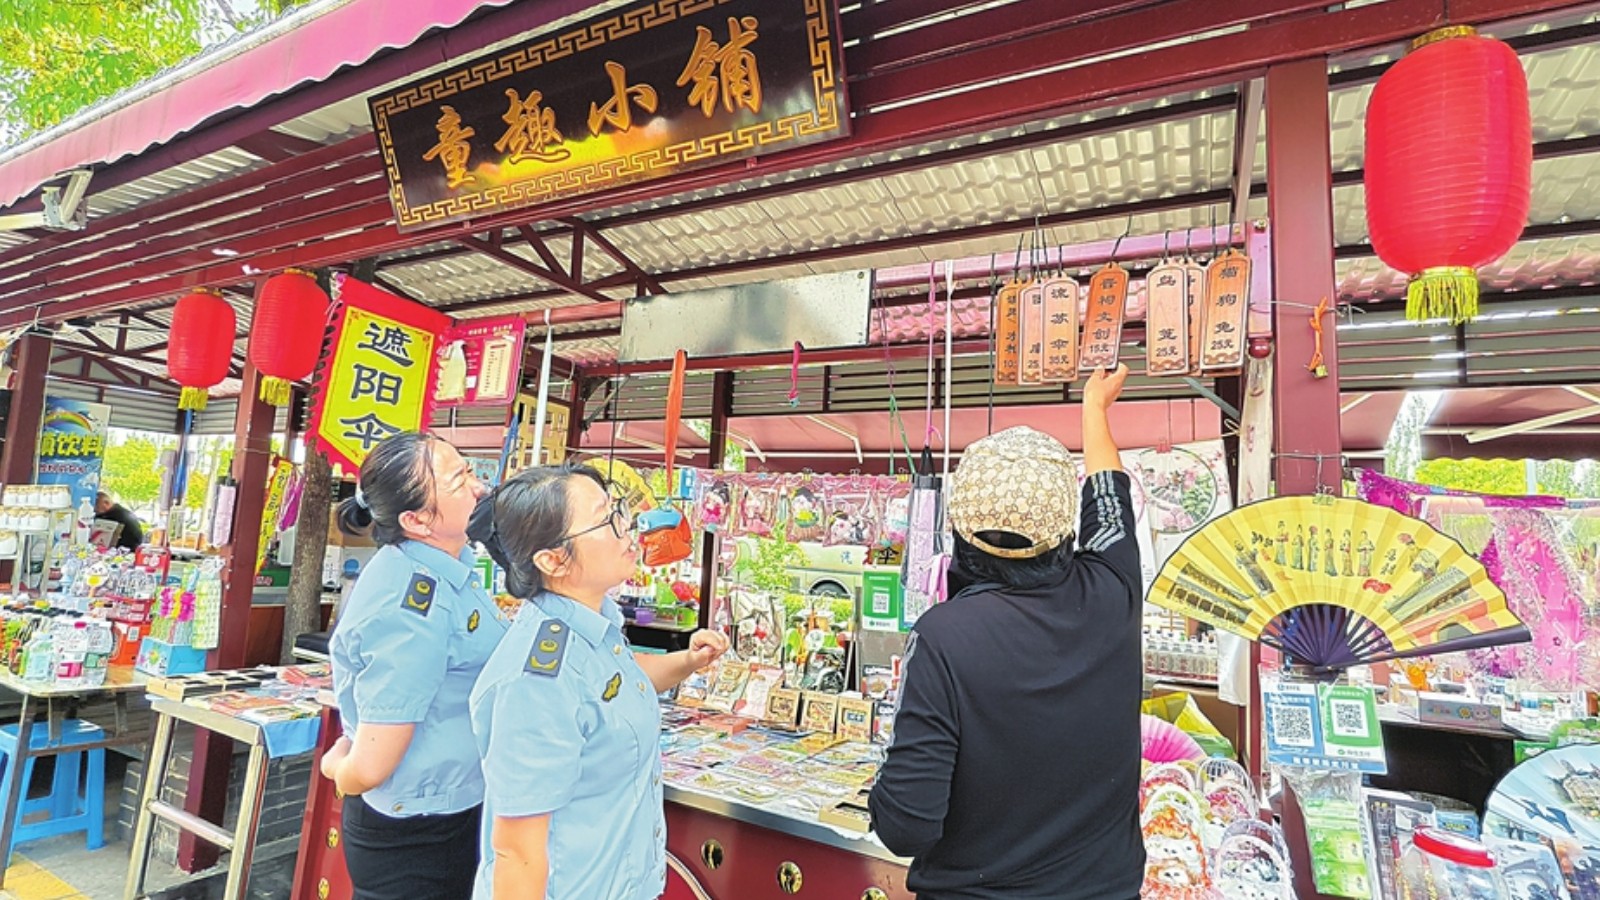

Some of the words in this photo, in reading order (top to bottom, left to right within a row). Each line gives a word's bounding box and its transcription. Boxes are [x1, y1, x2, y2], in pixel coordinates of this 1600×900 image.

[422, 16, 763, 189] 童趣小铺
[1050, 287, 1069, 350] 流苏伞
[1092, 278, 1118, 340] 晋祠文创
[1156, 275, 1178, 341] 鸟笼
[1214, 267, 1238, 334] 猫狗兔
[1089, 343, 1109, 354] 15元
[1155, 346, 1178, 357] 25元
[1211, 338, 1234, 351] 25元
[340, 321, 416, 450] 遮阳伞
